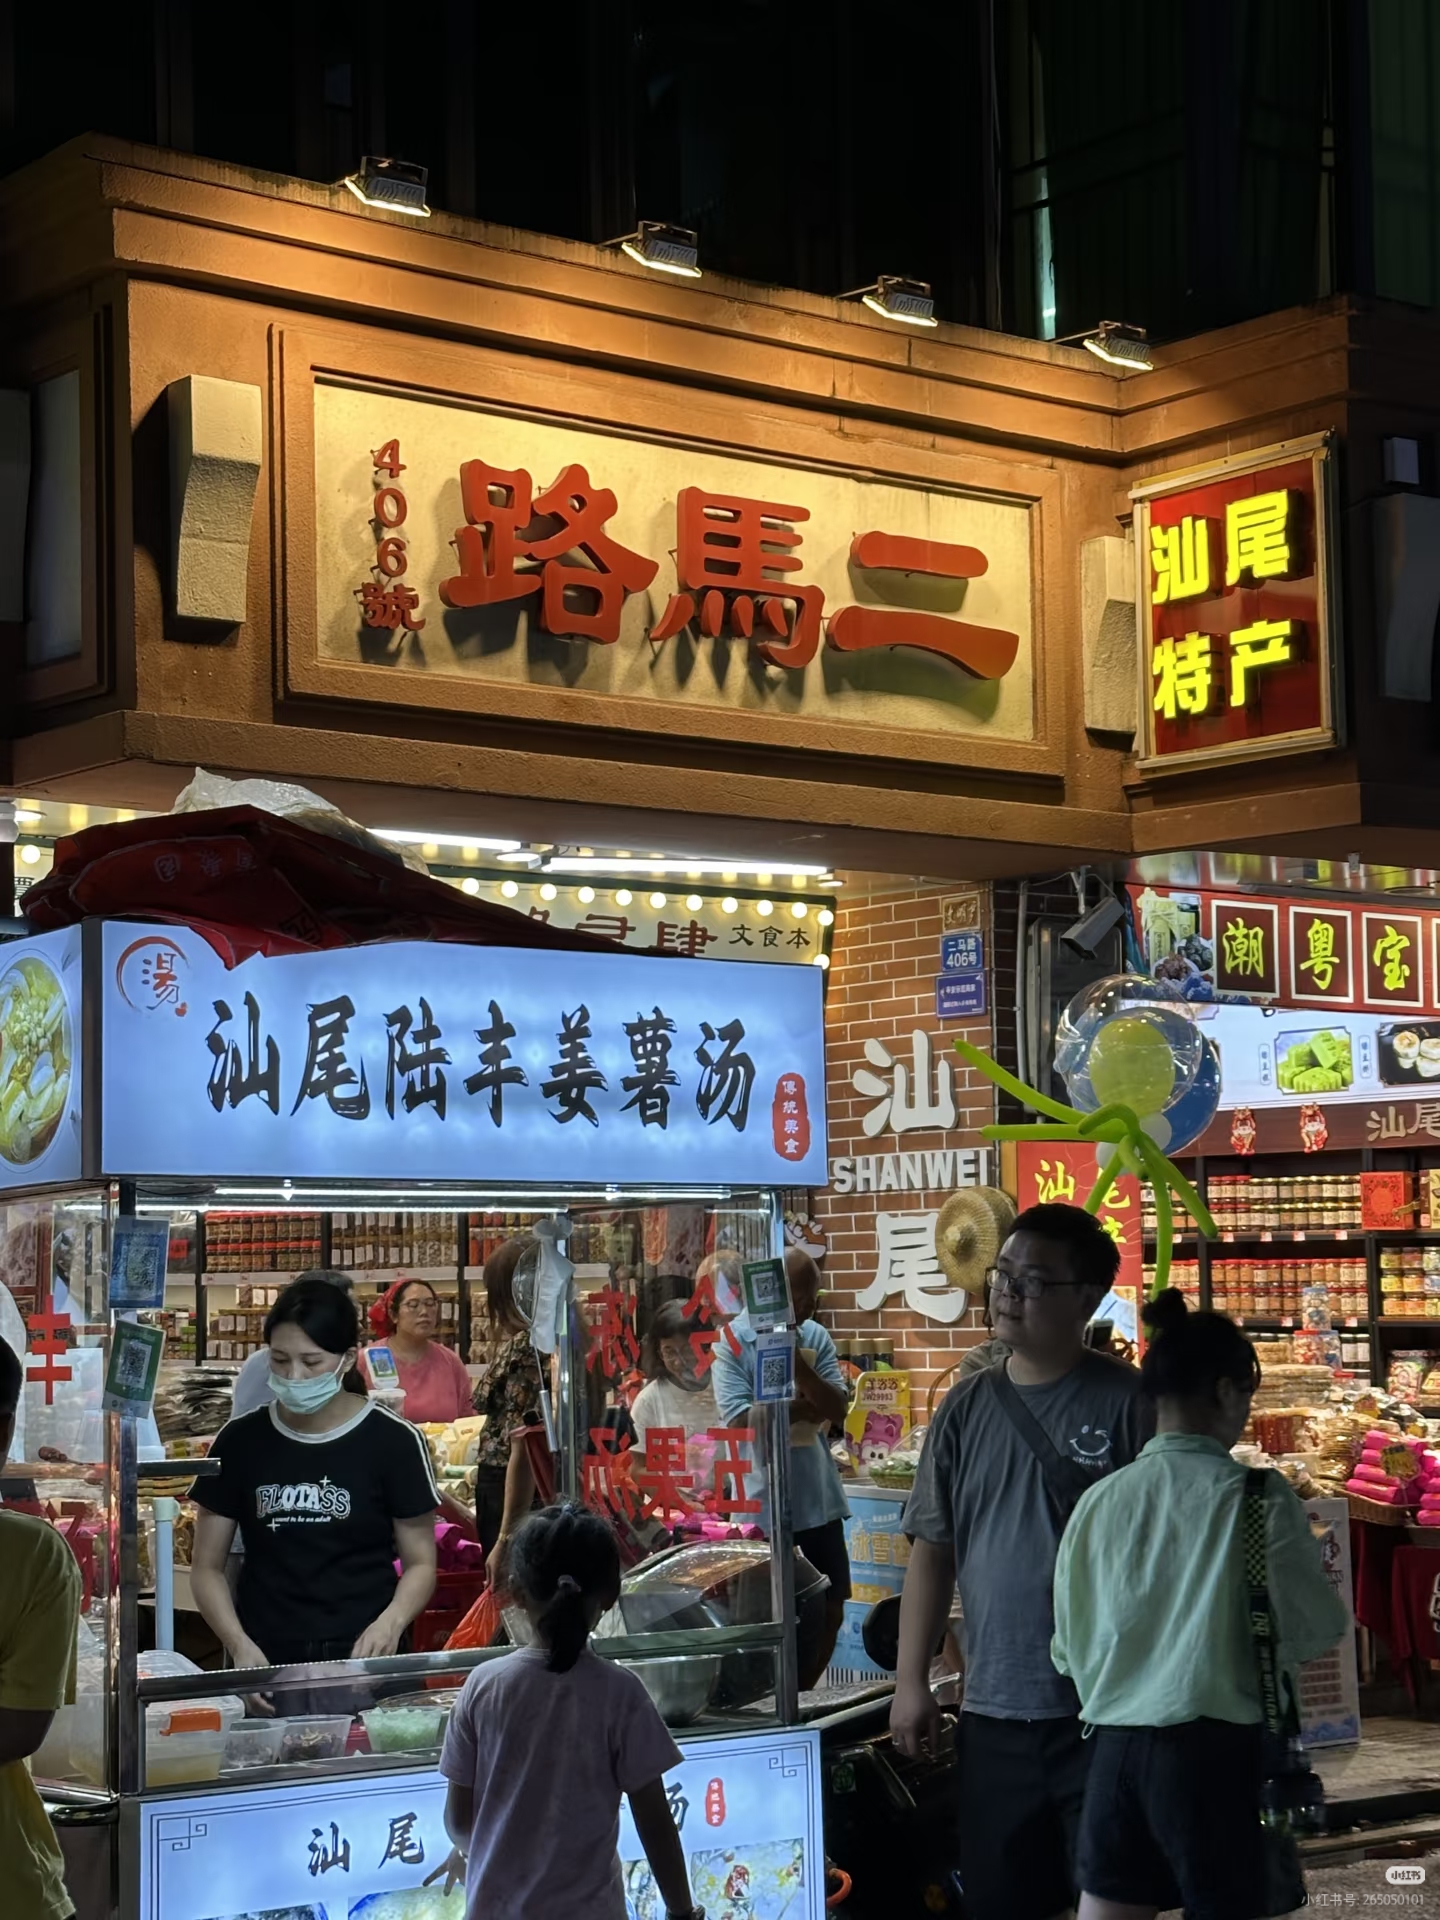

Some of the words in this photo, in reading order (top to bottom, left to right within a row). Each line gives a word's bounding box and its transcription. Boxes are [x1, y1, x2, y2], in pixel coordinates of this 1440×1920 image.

[1150, 488, 1291, 606] 汕尾
[1151, 619, 1292, 718] 特产
[946, 952, 977, 968] 406号
[948, 938, 976, 952] 二马路
[205, 990, 757, 1132] 汕尾陆丰姜薯汤
[834, 1149, 988, 1194] SHANWEI
[256, 1483, 351, 1519] FLOTASS
